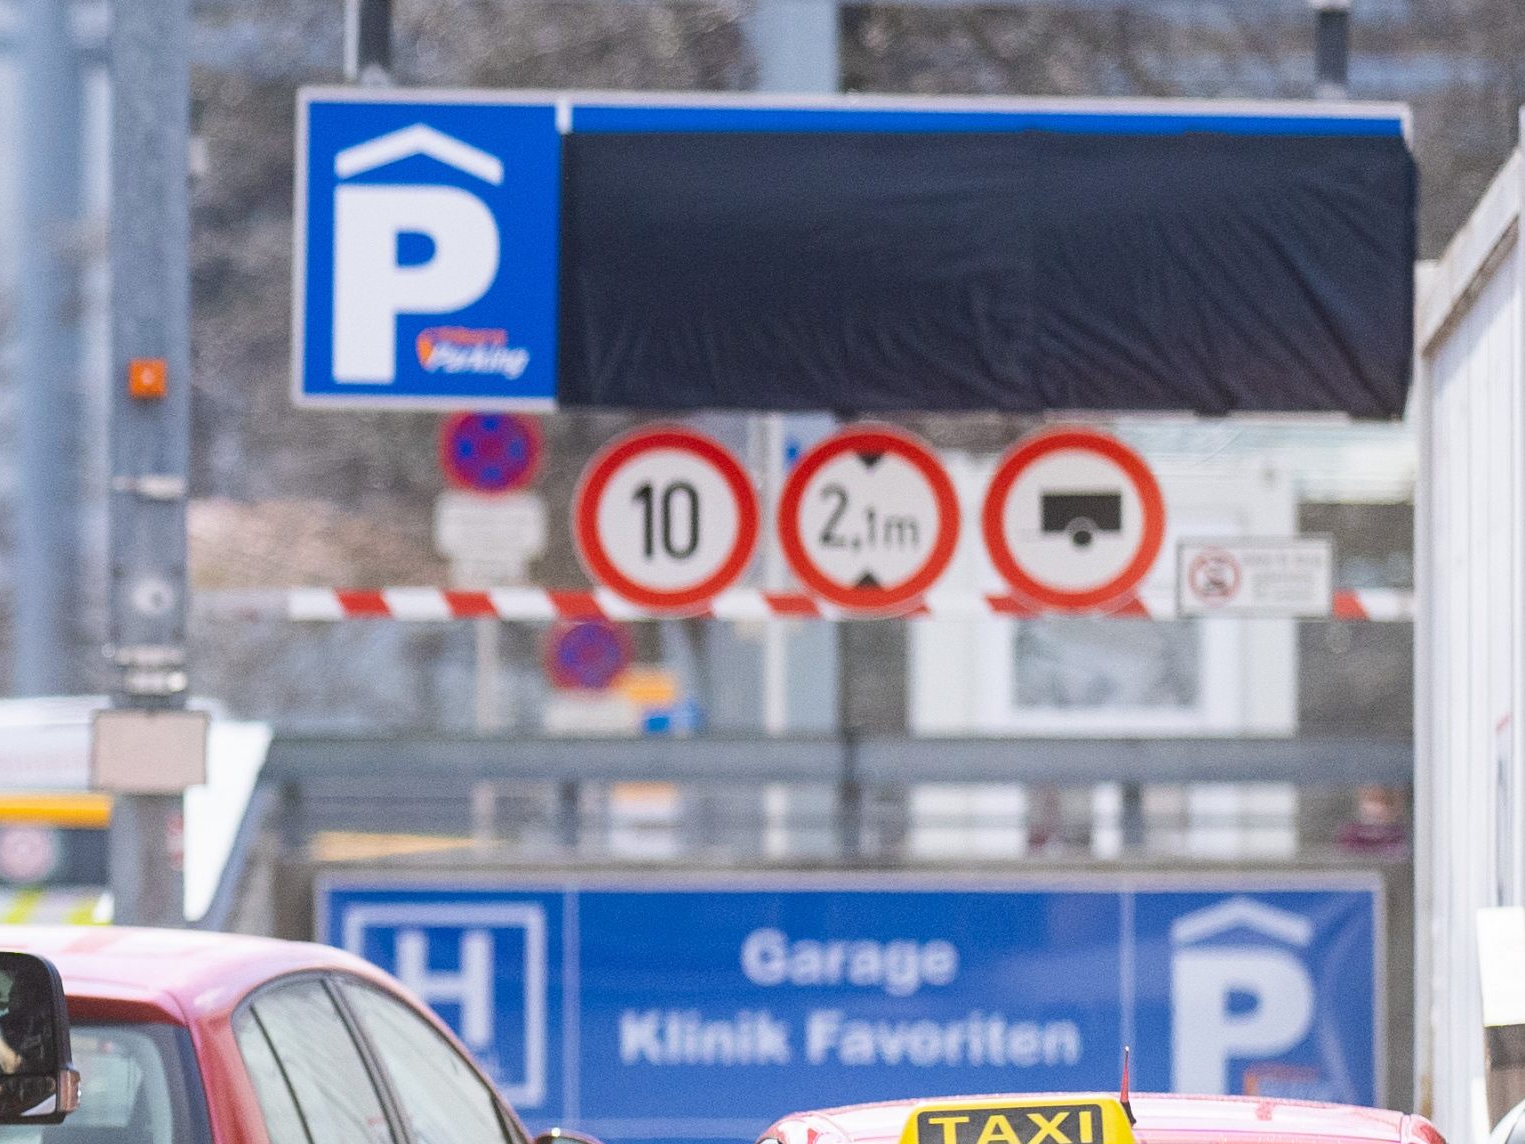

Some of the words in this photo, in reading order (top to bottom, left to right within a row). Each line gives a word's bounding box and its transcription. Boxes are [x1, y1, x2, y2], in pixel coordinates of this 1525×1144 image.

[333, 183, 500, 384] P
[632, 481, 700, 558] 10
[819, 483, 920, 551] 2,1m
[741, 927, 959, 996] Garage
[620, 1007, 790, 1066] Klinik
[806, 1007, 1081, 1067] Favoriten
[1171, 949, 1315, 1095] P
